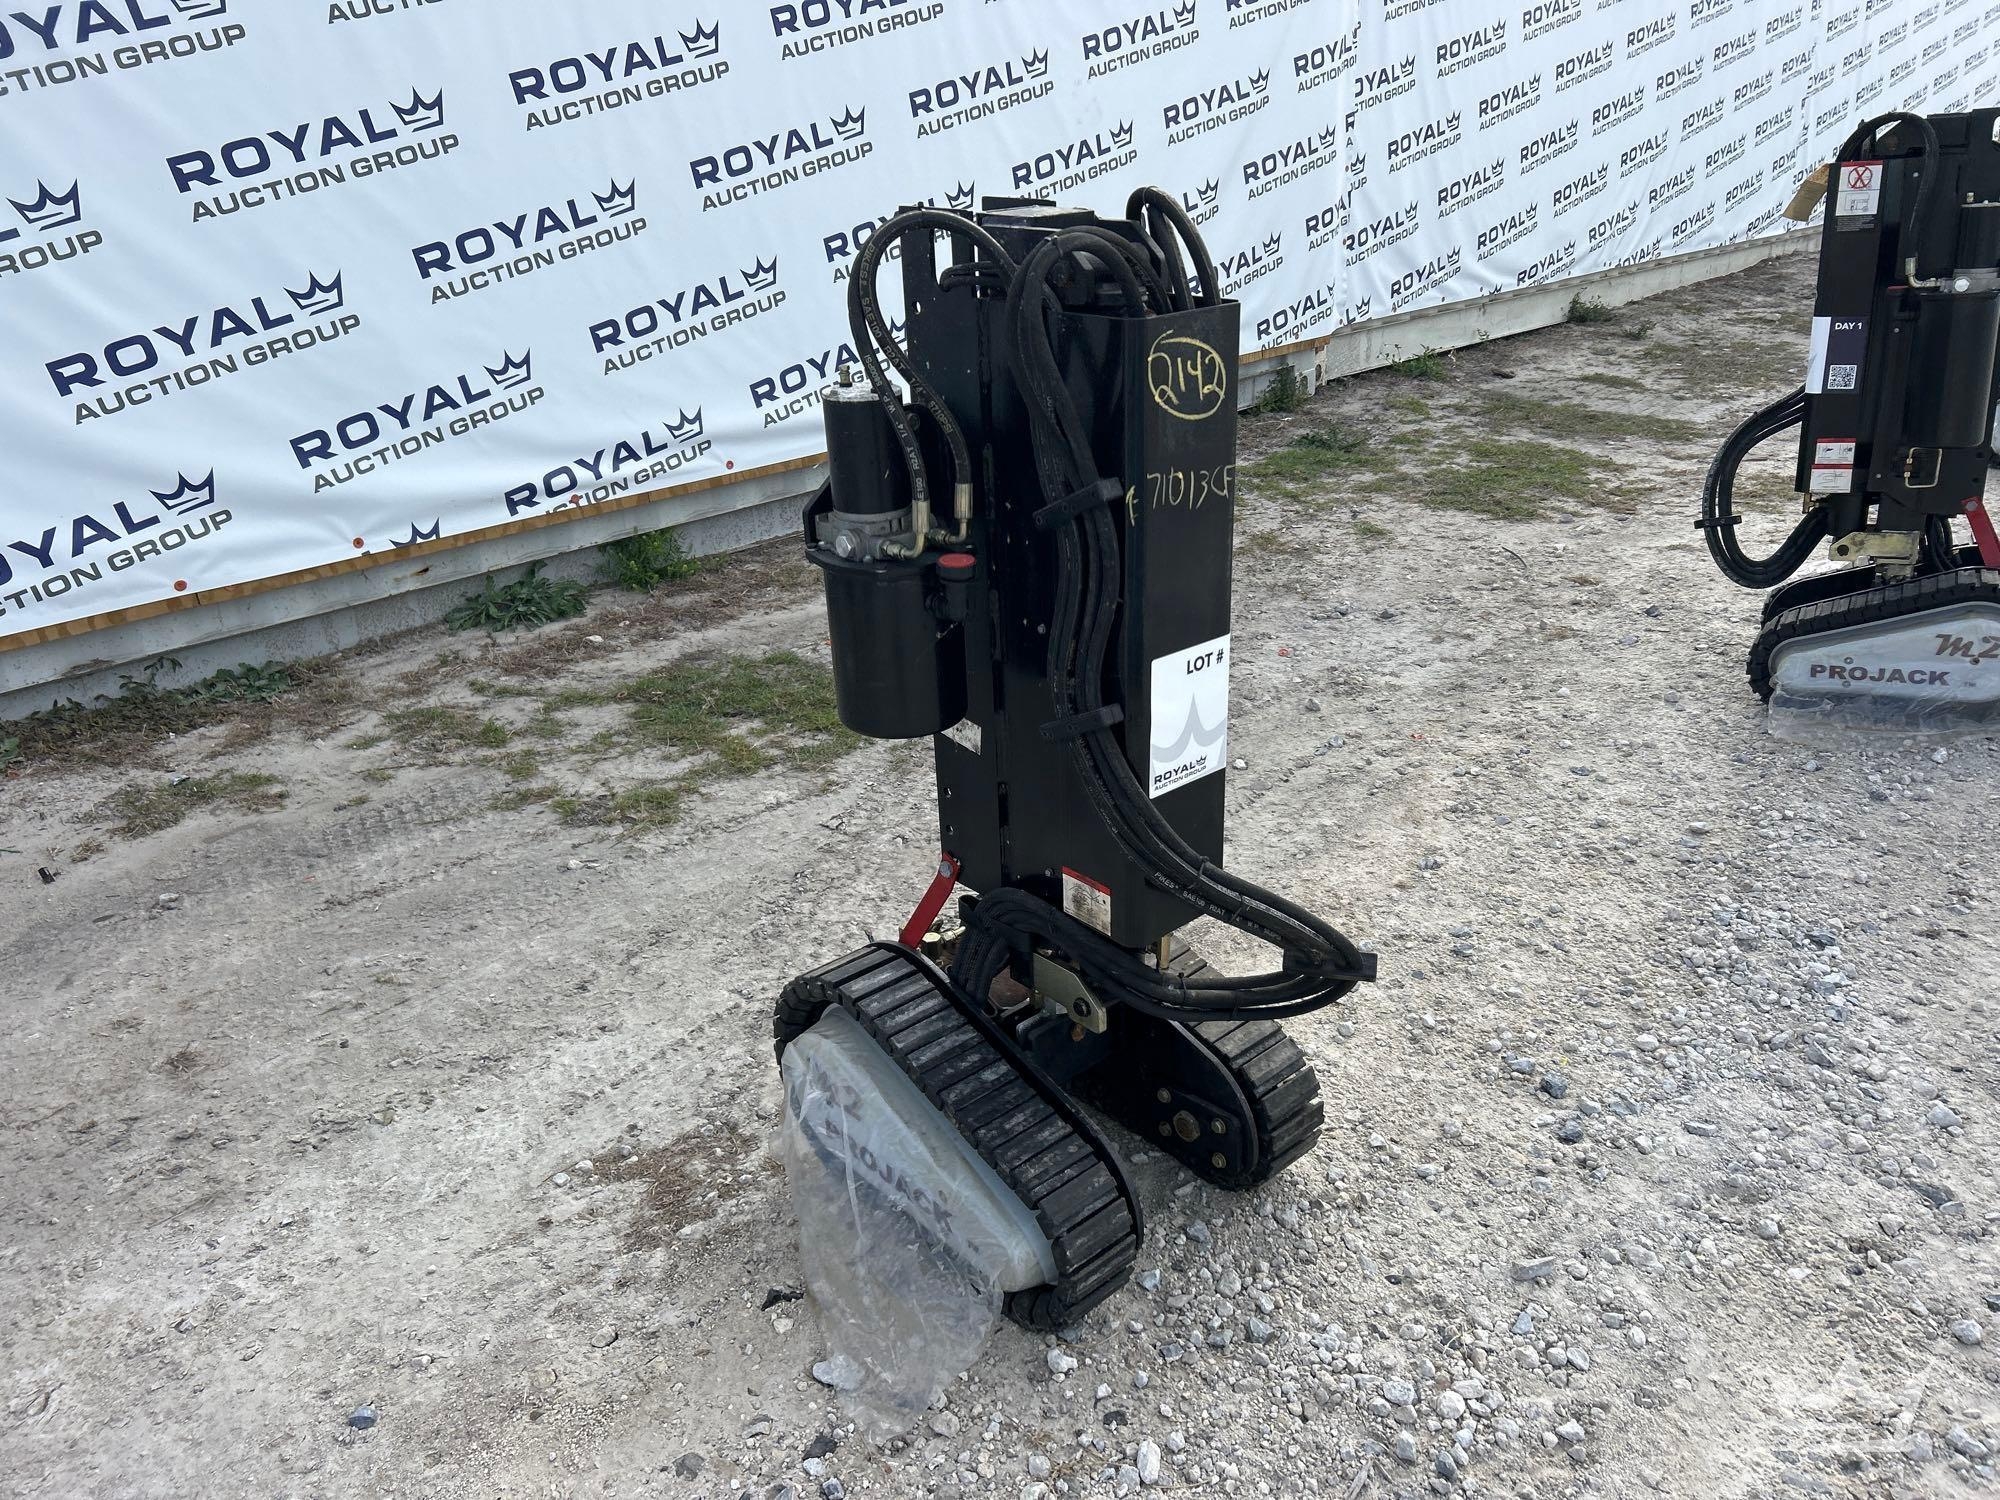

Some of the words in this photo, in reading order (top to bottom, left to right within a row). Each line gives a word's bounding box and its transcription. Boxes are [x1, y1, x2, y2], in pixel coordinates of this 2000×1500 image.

[0, 0, 171, 60] YAL
[1229, 1, 1288, 30] AUCTION
[1384, 1, 1426, 22] AUCTION
[1522, 0, 1570, 29] ROYAL
[1522, 22, 1555, 43] AUCTION
[1555, 10, 1582, 28] GROUP
[1766, 10, 1795, 35] ROYAL
[781, 22, 874, 61] AUCTION
[877, 3, 944, 34] GROUP
[1082, 10, 1174, 60] ROYAL
[1436, 27, 1492, 64] ROYAL
[1626, 19, 1667, 48] ROYAL
[1626, 40, 1654, 60] AUCTION
[1654, 30, 1675, 47] GROUP
[1713, 34, 1748, 61] ROYAL
[0, 53, 108, 98] TION
[115, 23, 246, 69] GROUP
[508, 36, 684, 105] ROYAL
[1088, 45, 1150, 80] AUCTION
[1152, 29, 1199, 57] GROUP
[1437, 54, 1476, 79] AUCTION
[1477, 42, 1507, 62] GROUP
[1555, 47, 1602, 81] ROYAL
[526, 85, 642, 131] AUCTION
[645, 60, 730, 98] GROUP
[908, 61, 1024, 118] ROYAL
[1384, 79, 1416, 101] GROUP
[1555, 72, 1588, 94] AUCTION
[1588, 60, 1613, 79] GROUP
[1656, 61, 1695, 91] ROYAL
[1734, 76, 1766, 103] ROYAL
[917, 100, 995, 139] AUCTION
[997, 80, 1054, 111] GROUP
[1163, 79, 1250, 130] ROYAL
[1478, 81, 1529, 118] ROYAL
[1479, 108, 1514, 132] AUCTION
[1515, 94, 1541, 114] GROUP
[1592, 92, 1634, 125] ROYAL
[1682, 103, 1715, 132] ROYAL
[1167, 113, 1227, 147] AUCTION
[1229, 95, 1269, 122] GROUP
[1592, 115, 1622, 137] AUCTION
[1622, 103, 1644, 122] GROUP
[1755, 110, 1786, 138] ROYAL
[166, 108, 398, 194] ROYAL
[689, 122, 834, 189] ROYAL
[1387, 120, 1446, 160] ROYAL
[1388, 147, 1428, 175] AUCTION
[1429, 132, 1461, 155] GROUP
[1520, 127, 1566, 164] ROYAL
[1520, 153, 1553, 177] AUCTION
[1553, 138, 1578, 159] GROUP
[1620, 132, 1659, 167] ROYAL
[1705, 140, 1739, 169] ROYAL
[193, 164, 346, 223] AUCTION
[351, 133, 459, 178] GROUP
[702, 166, 799, 212] AUCTION
[802, 141, 874, 178] GROUP
[1011, 133, 1111, 190] ROYAL
[1088, 149, 1137, 180] GROUP
[1242, 137, 1319, 185] ROYAL
[1248, 167, 1299, 200] AUCTION
[1301, 150, 1337, 176] GROUP
[1437, 165, 1491, 207] ROYAL
[1438, 194, 1475, 219] AUCTION
[1476, 178, 1504, 200] GROUP
[1553, 171, 1597, 207] ROYAL
[1553, 196, 1584, 219] AUCTION
[1584, 182, 1608, 201] GROUP
[1649, 172, 1686, 204] ROYAL
[1725, 177, 1757, 204] ROYAL
[412, 198, 598, 279] ROYAL
[1345, 211, 1405, 251] ROYAL
[1477, 212, 1526, 250] ROYAL
[1477, 238, 1512, 262] AUCTION
[1512, 222, 1538, 243] GROUP
[1588, 208, 1629, 244] ROYAL
[1672, 207, 1707, 239] ROYAL
[0, 229, 103, 278] ROUP
[431, 249, 554, 304] AUCTION
[558, 217, 647, 261] GROUP
[1345, 239, 1386, 267] AUCTION
[1387, 222, 1419, 247] GROUP
[1243, 256, 1283, 285] GROUP
[1390, 257, 1446, 299] ROYAL
[1516, 249, 1564, 286] ROYAL
[1549, 257, 1576, 278] GROUP
[1391, 286, 1429, 312] AUCTION
[1431, 266, 1461, 289] GROUP
[589, 276, 744, 354] ROYAL
[603, 324, 707, 376] AUCTION
[711, 290, 786, 331] GROUP
[862, 297, 882, 338] SAE100
[884, 345, 906, 371] R2AT
[1256, 289, 1328, 341] ROYAL
[1309, 307, 1332, 326] GRO
[1835, 322, 1855, 330] DAY
[1857, 322, 1862, 330] 1
[45, 297, 294, 397] ROYAL
[75, 354, 238, 425] AUCTION
[243, 314, 360, 366] GROUP
[1149, 350, 1225, 404] 2142
[290, 374, 491, 469] ROYAL
[314, 427, 445, 493] AUCTION
[449, 386, 545, 437] GROUP
[504, 430, 668, 517] ROYAL
[633, 439, 711, 485] GROUP
[906, 446, 920, 470] R2AT
[0, 501, 161, 588] YAL
[0, 563, 103, 618] TION
[109, 509, 232, 572] GROUP
[1186, 652, 1214, 675] LOT
[1216, 648, 1225, 664] #
[1810, 663, 1950, 687] PROJACK
[1154, 761, 1196, 785] ROYAL
[1154, 775, 1184, 791] AUCTION
[1184, 765, 1207, 779] GROUP
[1154, 871, 1176, 889] PIKES
